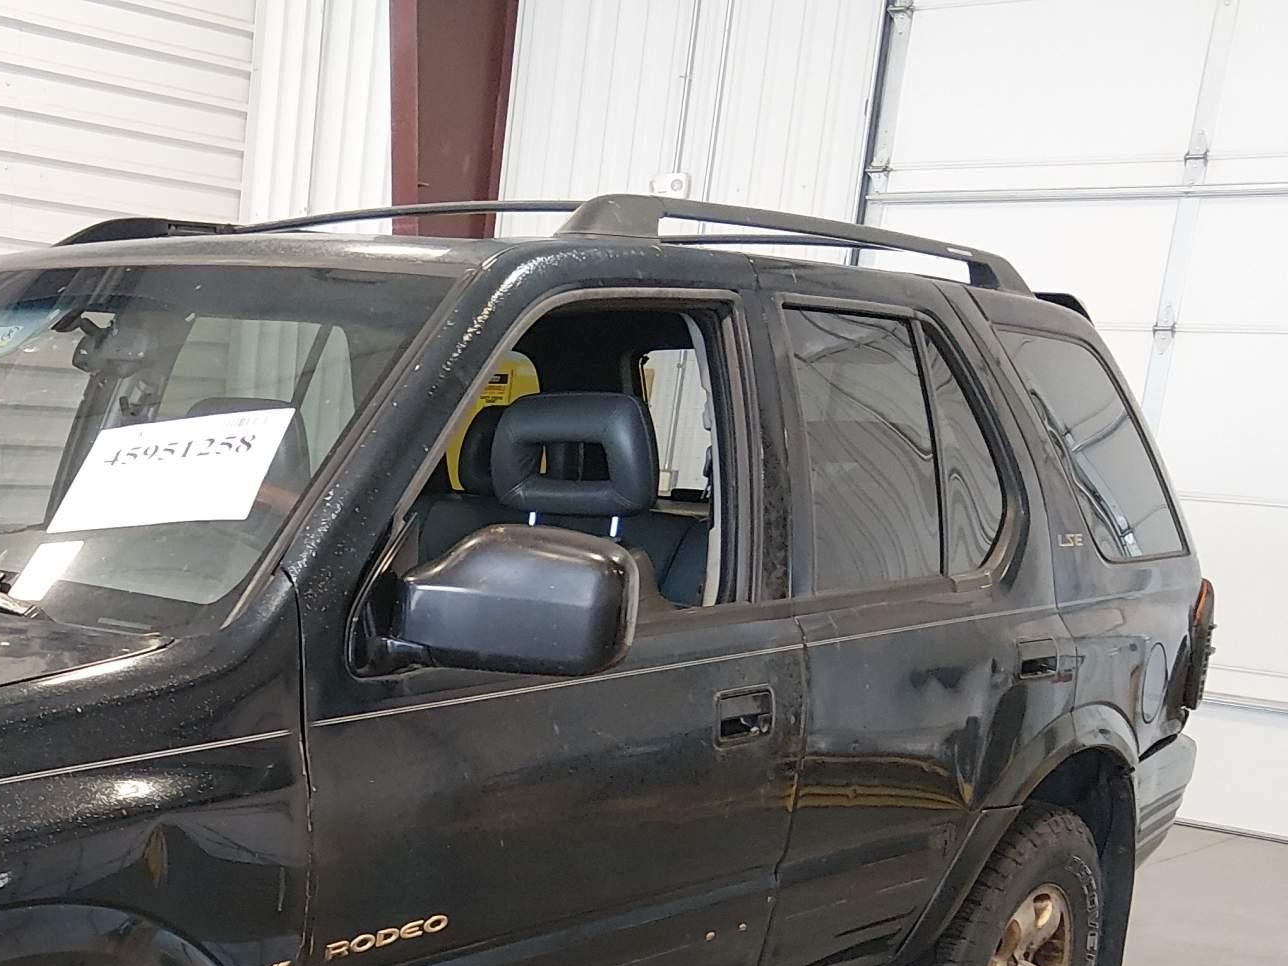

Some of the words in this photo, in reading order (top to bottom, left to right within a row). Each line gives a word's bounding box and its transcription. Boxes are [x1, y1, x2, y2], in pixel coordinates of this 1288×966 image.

[104, 434, 256, 465] 45951258
[1058, 533, 1084, 547] LSE
[325, 914, 449, 960] RODEO
